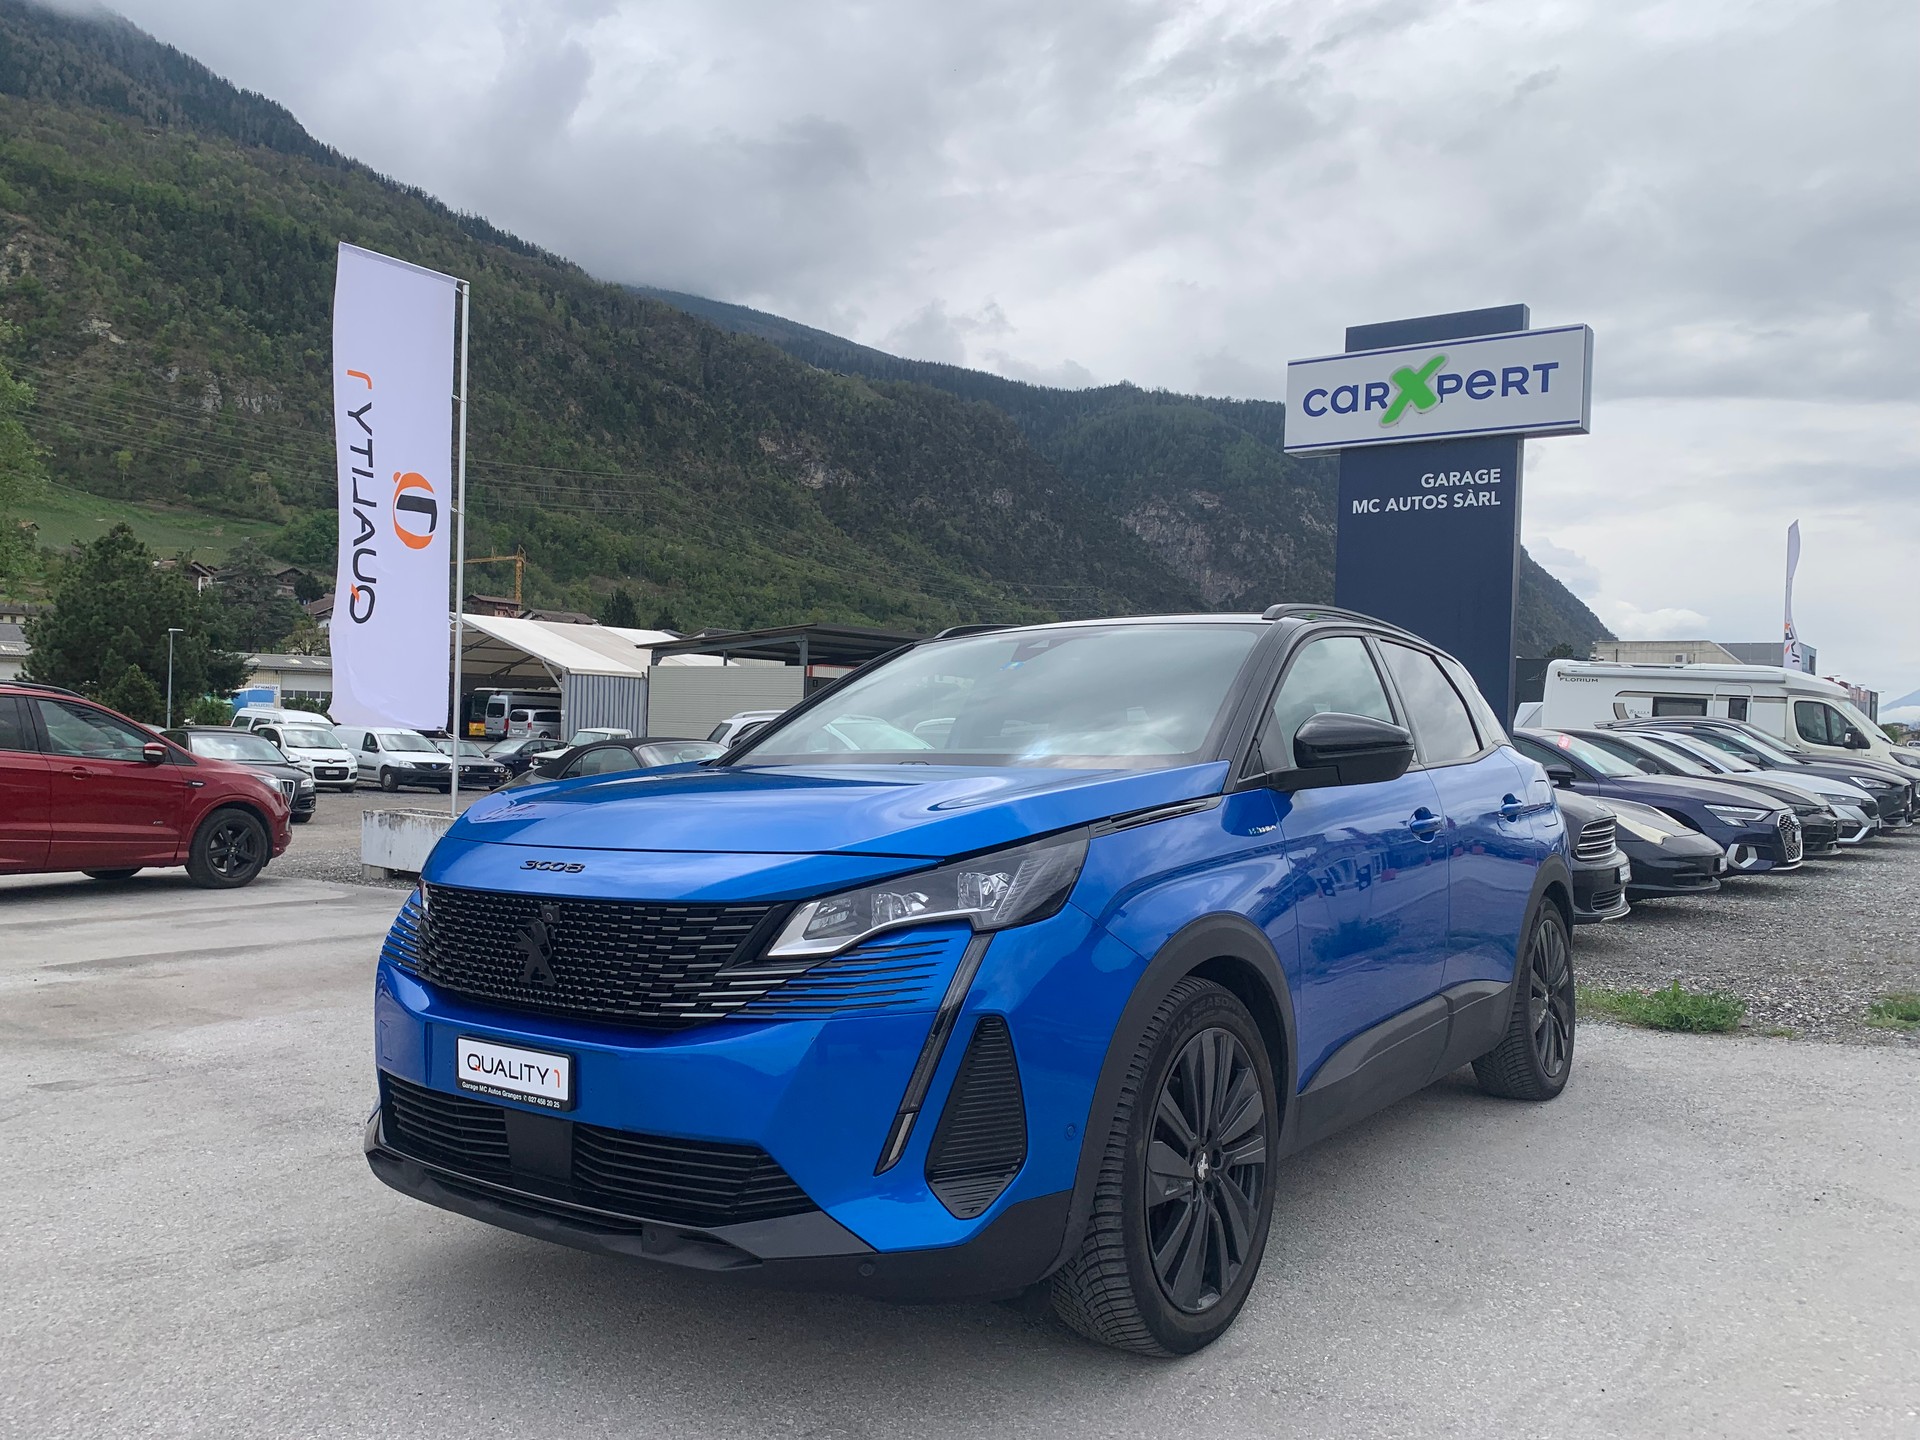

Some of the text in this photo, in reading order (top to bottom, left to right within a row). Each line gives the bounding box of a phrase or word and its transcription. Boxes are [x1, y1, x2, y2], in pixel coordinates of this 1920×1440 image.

[1420, 468, 1501, 488] GARAGE
[1352, 488, 1501, 514] MC AUTOS SÀRL
[520, 860, 585, 873] 3008
[467, 1053, 560, 1089] QUALITY 1
[462, 1081, 479, 1091] Garage
[479, 1084, 488, 1093] MC
[488, 1087, 501, 1096] Autos
